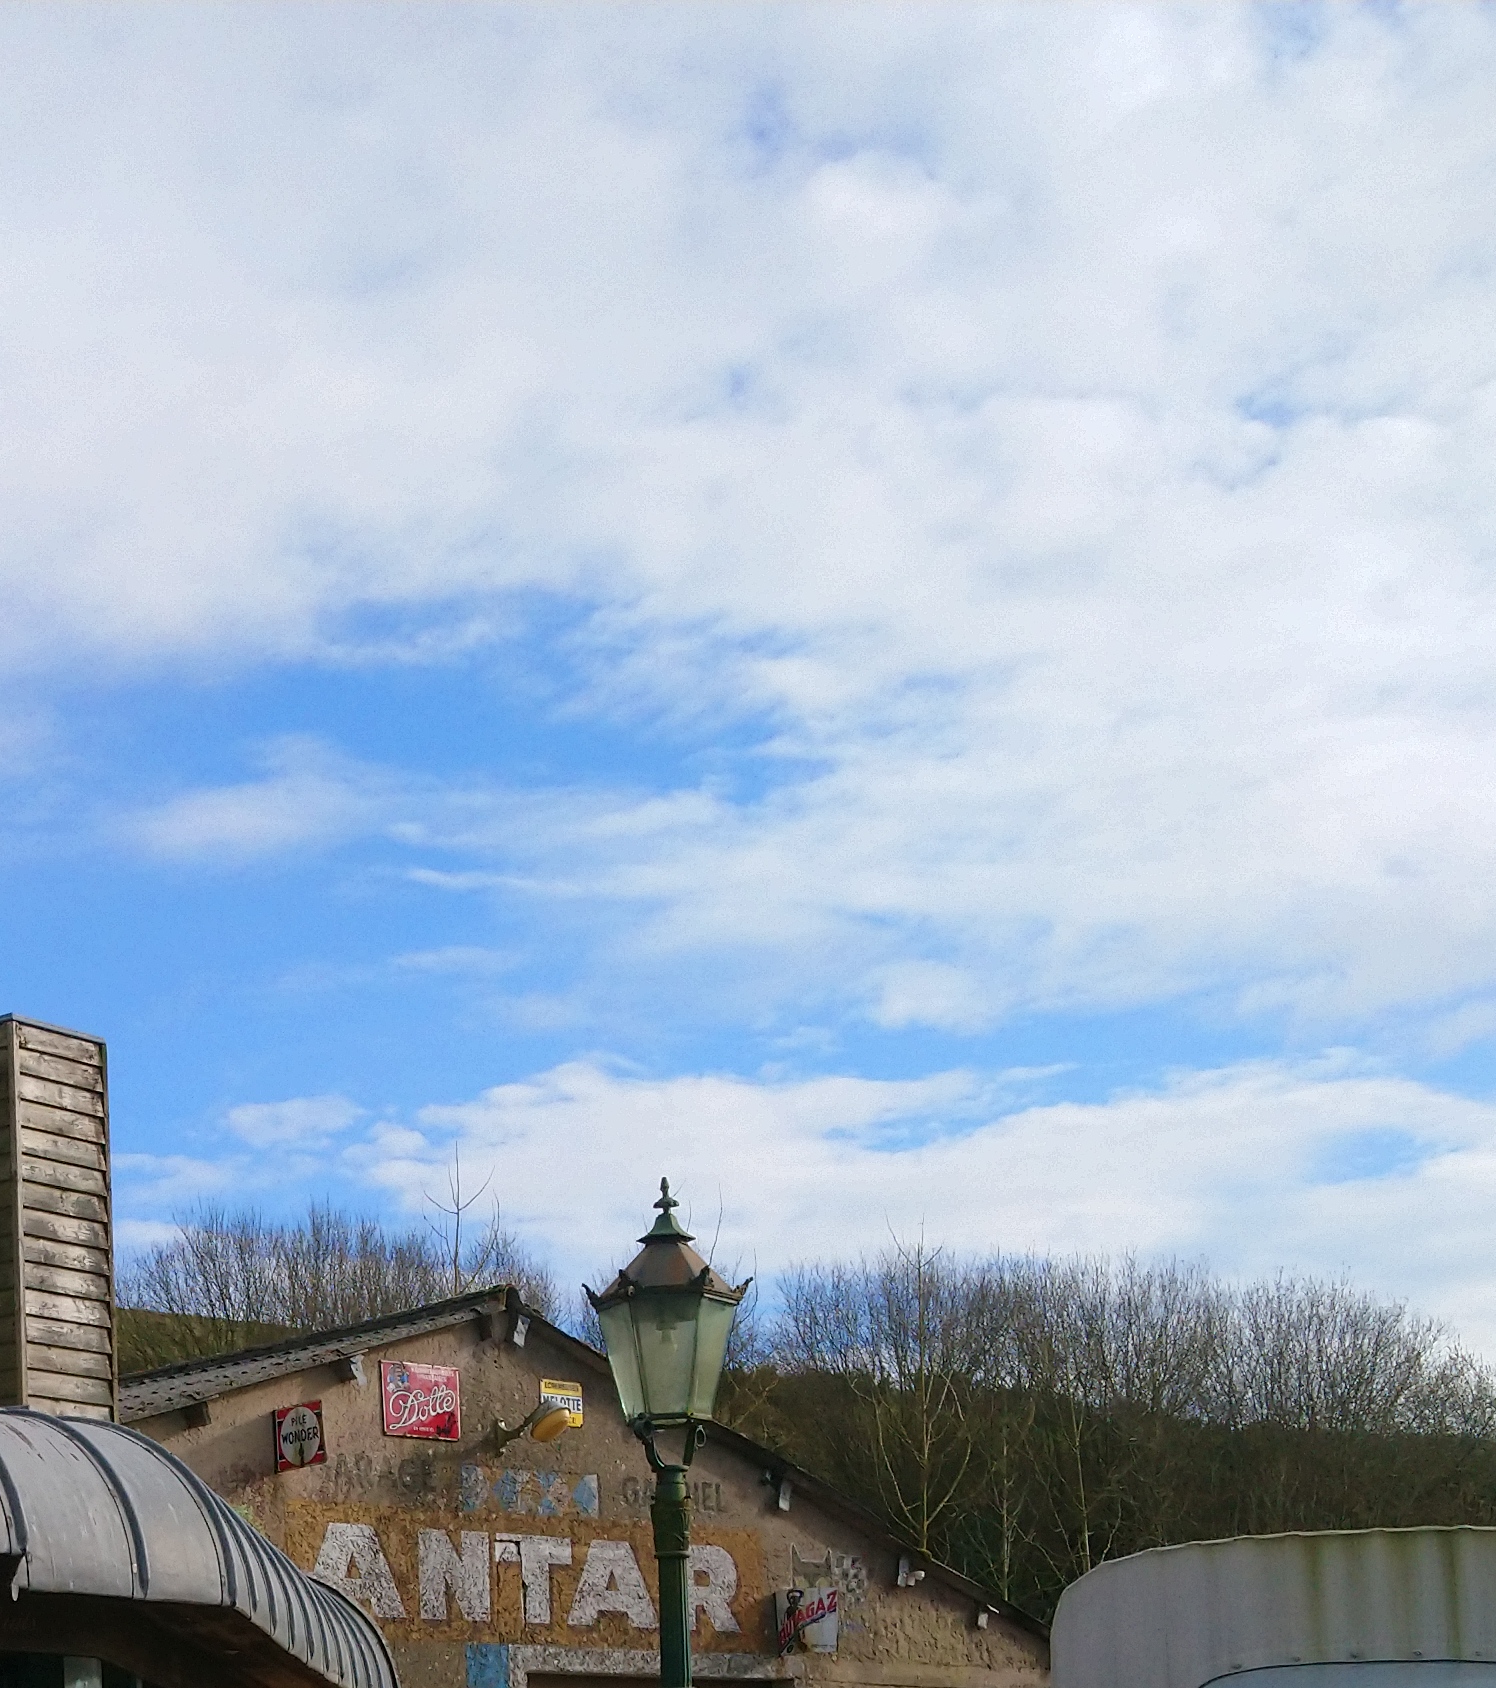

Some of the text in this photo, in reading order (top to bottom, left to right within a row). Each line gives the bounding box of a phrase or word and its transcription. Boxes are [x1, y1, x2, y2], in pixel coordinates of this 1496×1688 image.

[291, 1414, 307, 1427] PILE
[281, 1426, 319, 1445] WONDER
[311, 1522, 742, 1634] ANTAR
